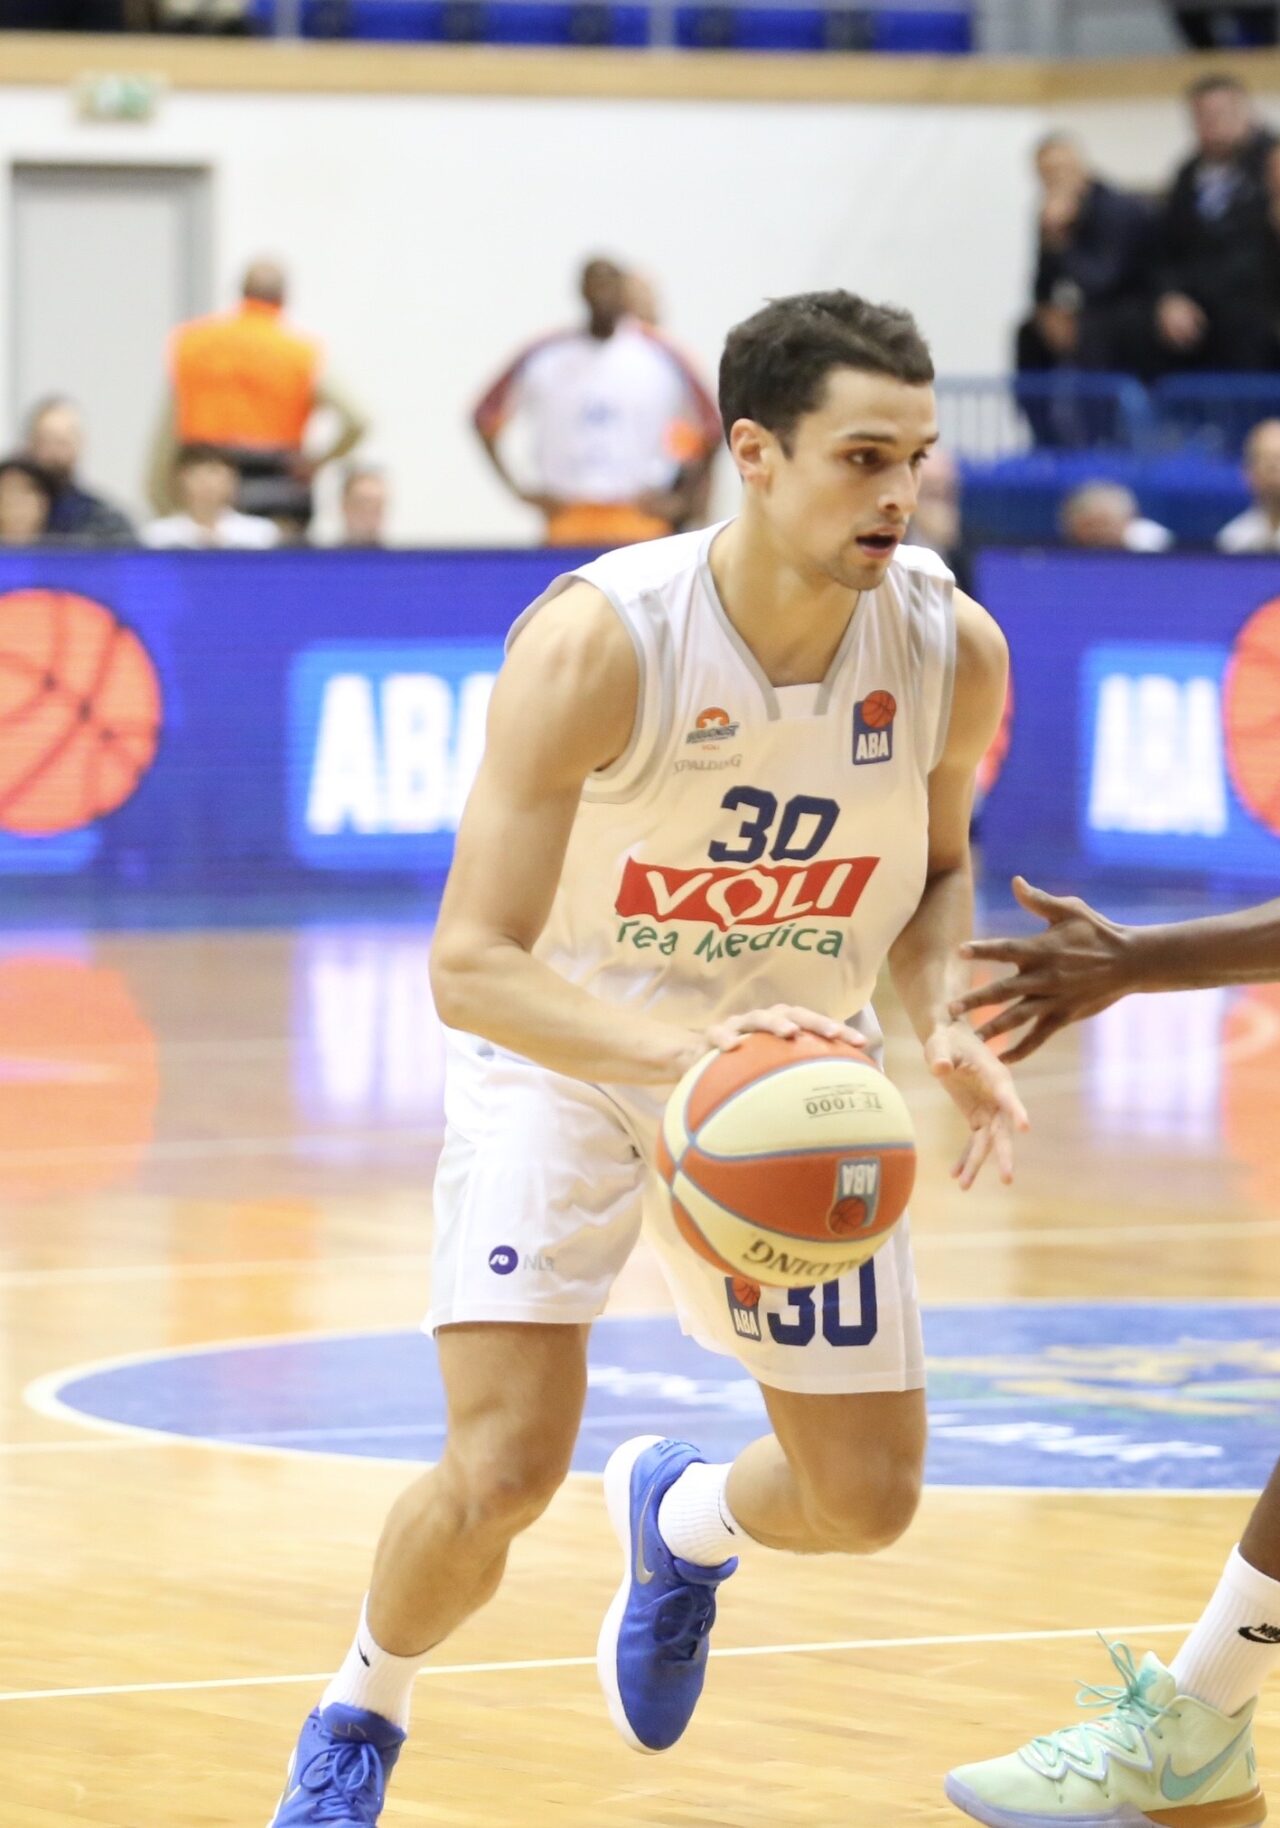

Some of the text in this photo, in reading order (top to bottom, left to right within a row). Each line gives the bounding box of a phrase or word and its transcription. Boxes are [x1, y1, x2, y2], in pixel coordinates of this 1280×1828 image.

[855, 731, 889, 760] ABA
[708, 785, 841, 864] 30
[645, 863, 854, 928] VOLI
[693, 922, 844, 963] Medica
[732, 1307, 760, 1337] ABA
[767, 1255, 878, 1347] 30
